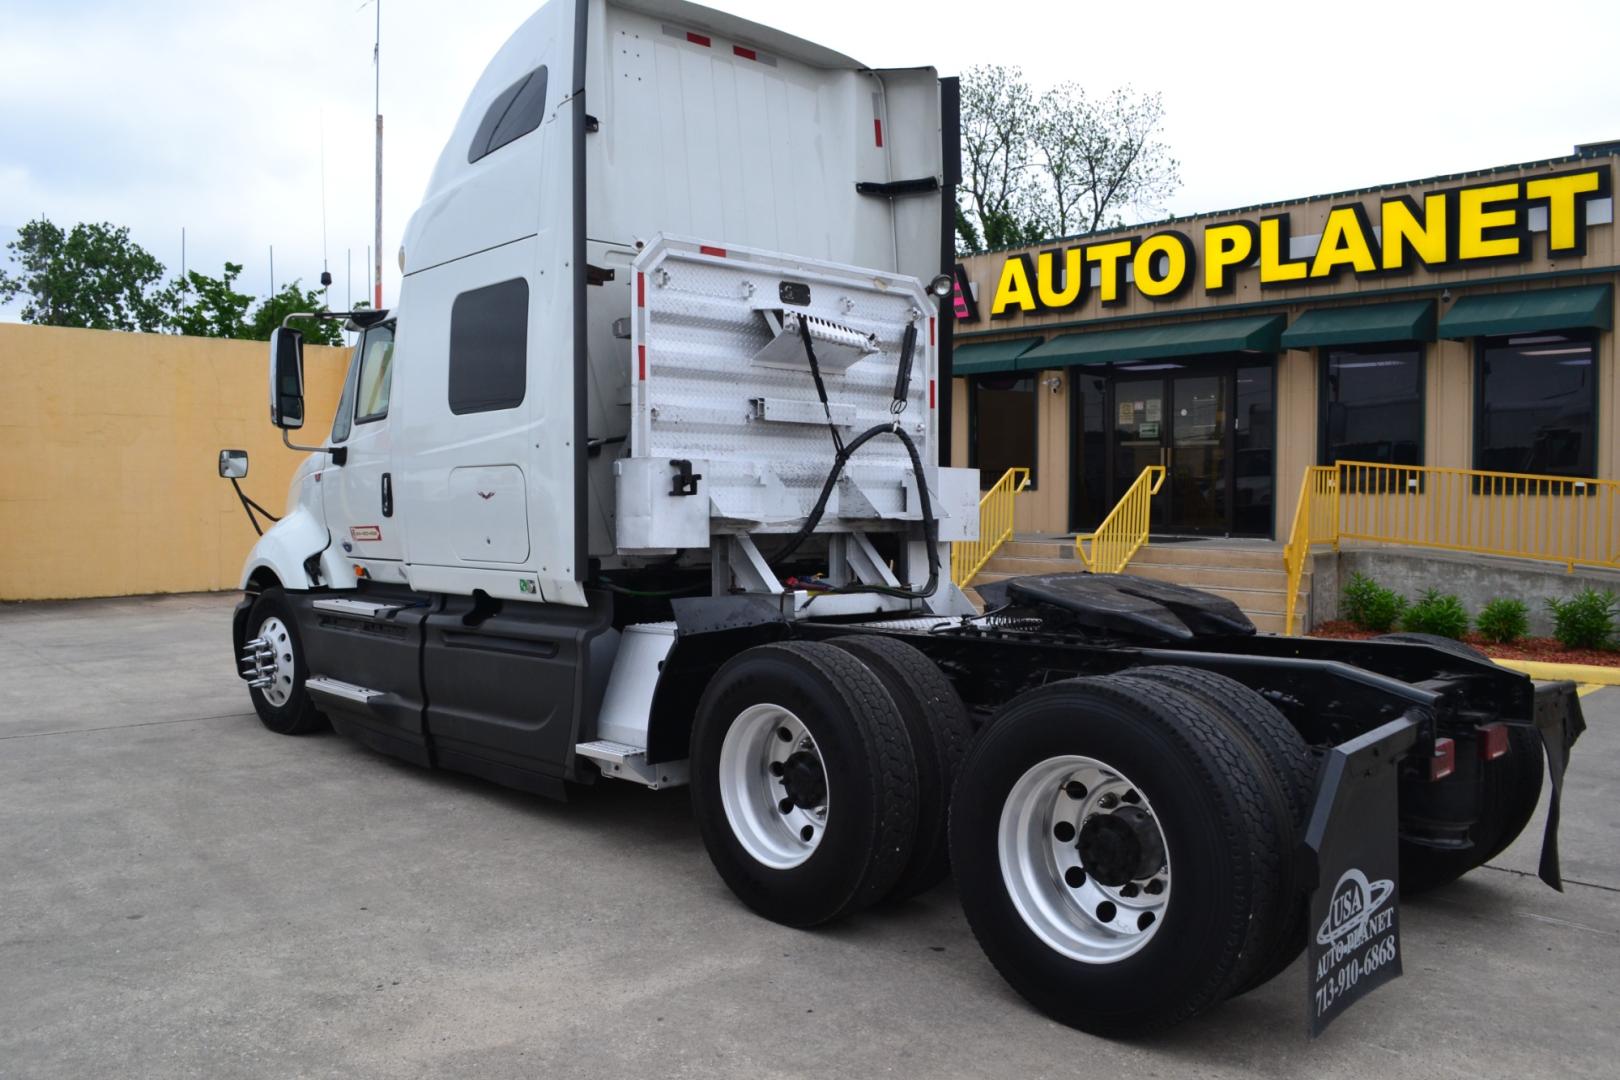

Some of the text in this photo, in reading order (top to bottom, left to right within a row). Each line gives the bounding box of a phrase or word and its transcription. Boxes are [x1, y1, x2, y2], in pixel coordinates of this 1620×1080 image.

[991, 232, 1189, 316] AUTO
[1204, 171, 1601, 291] PLANET
[1316, 907, 1394, 982] AUTO PLANET
[1334, 885, 1362, 927] USA
[1315, 934, 1396, 1017] 713-910-6868
